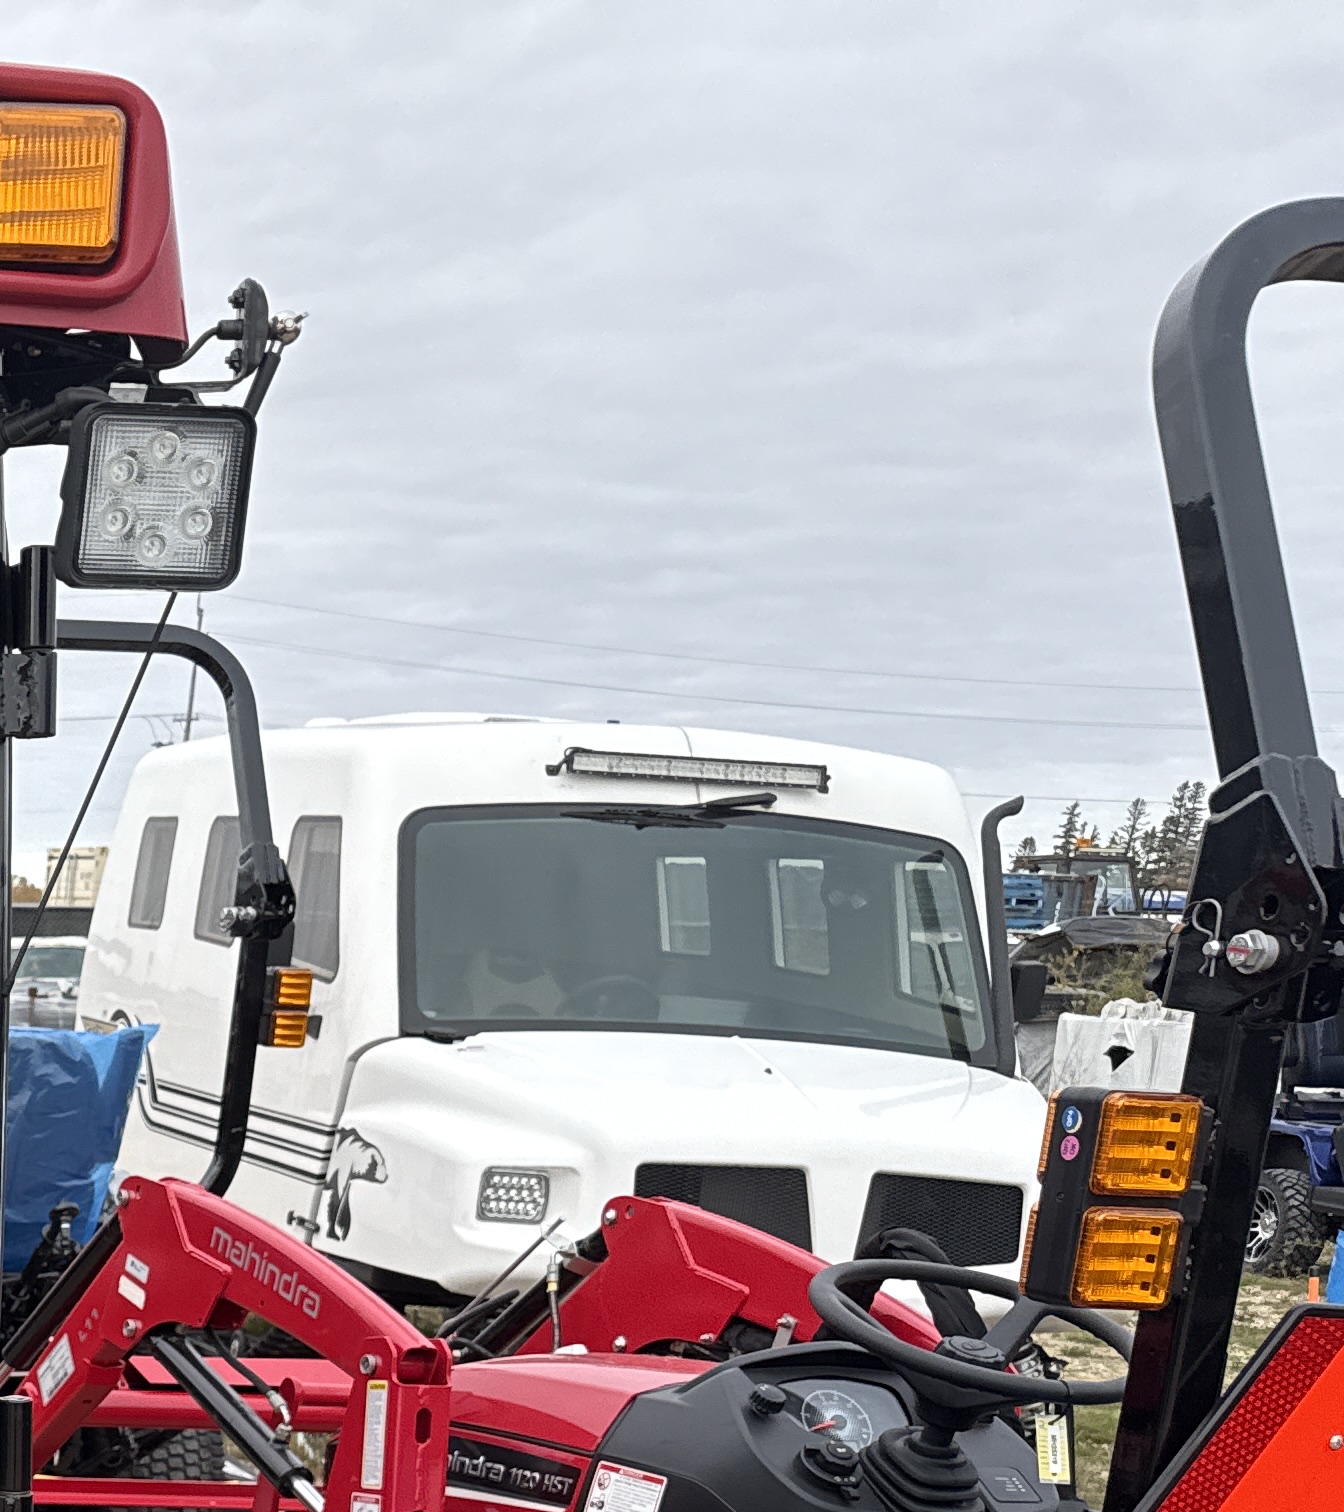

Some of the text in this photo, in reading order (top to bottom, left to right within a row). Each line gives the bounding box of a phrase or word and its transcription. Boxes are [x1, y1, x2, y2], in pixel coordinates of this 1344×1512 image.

[209, 1225, 322, 1320] mahindra
[447, 1449, 506, 1483] indra
[508, 1467, 541, 1490] 1120
